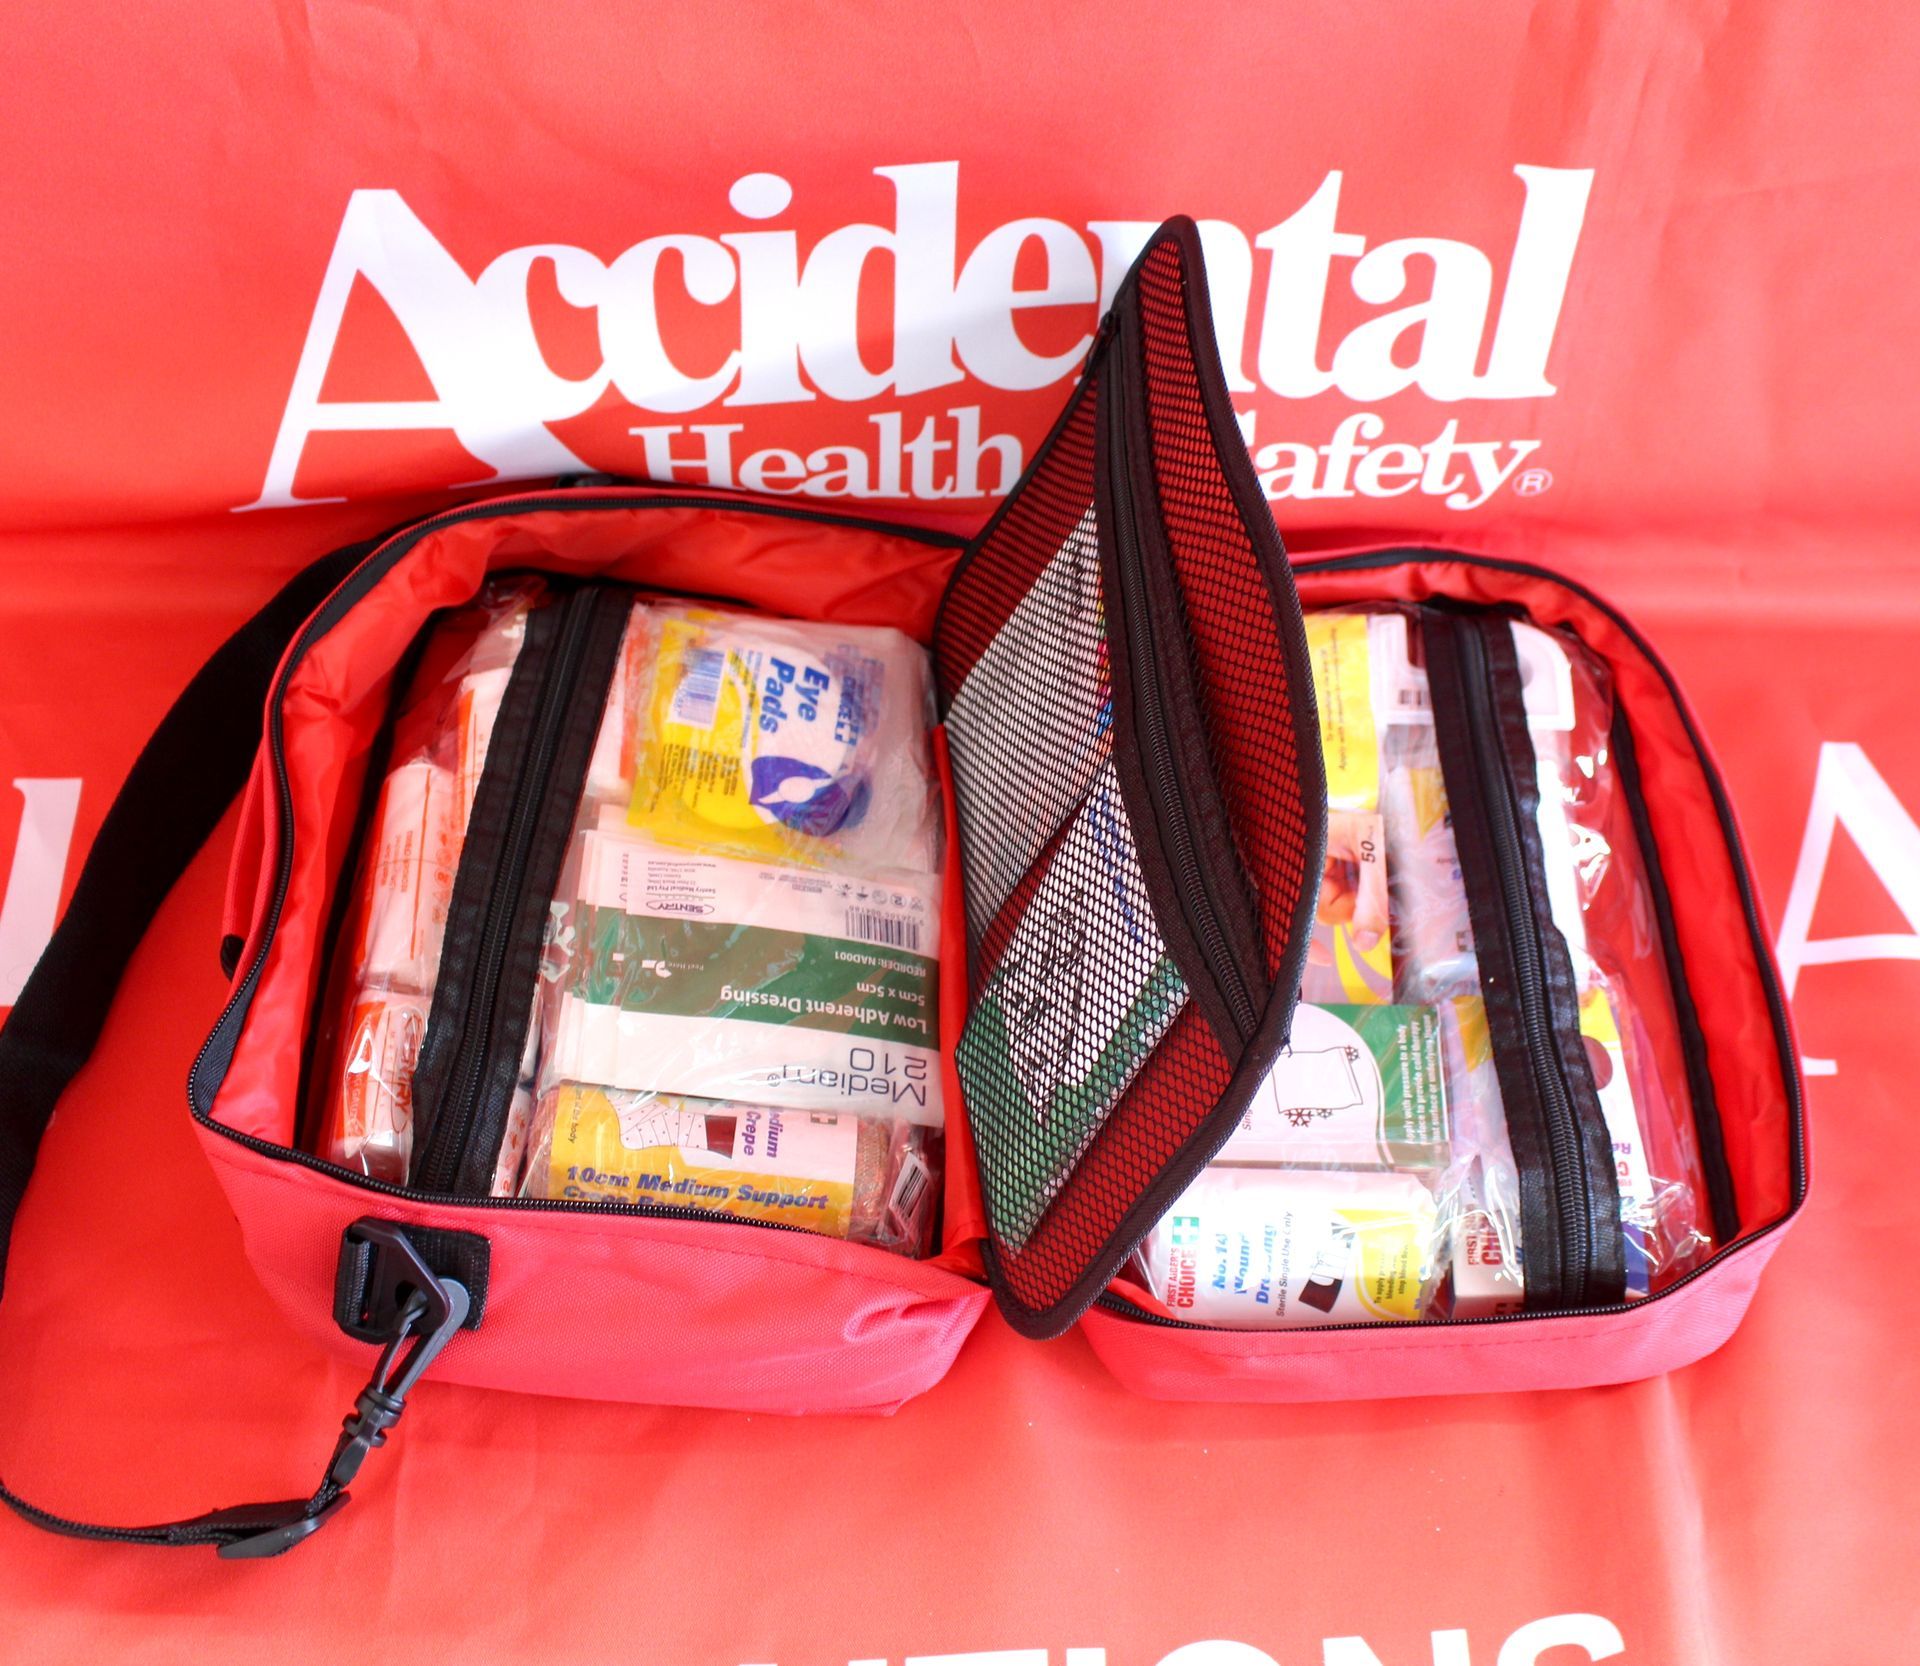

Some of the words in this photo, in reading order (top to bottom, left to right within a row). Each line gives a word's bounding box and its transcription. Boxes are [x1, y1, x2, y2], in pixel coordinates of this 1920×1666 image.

[629, 406, 1024, 500] Health
[759, 657, 797, 734] Pads
[794, 666, 830, 722] Eye
[1360, 840, 1377, 864] 50
[657, 902, 704, 915] SENTRY
[834, 950, 876, 967] NAD001
[878, 957, 927, 978] REORDER:
[720, 985, 803, 1013] Dressing
[856, 982, 886, 998] 5cm
[898, 990, 926, 1006] 5cm
[806, 998, 891, 1026] Adherent
[893, 1012, 928, 1034] Low
[849, 1047, 928, 1081] 210
[568, 1122, 580, 1145] body
[742, 1110, 763, 1157] Crepe
[567, 1165, 630, 1188] 10cm
[636, 1173, 731, 1200] Medium
[736, 1183, 830, 1210] Support
[1281, 1238, 1292, 1257] Use
[1176, 1248, 1197, 1309] CHOICE
[1278, 1258, 1292, 1288] Single
[1385, 1271, 1397, 1300] bleeding
[1166, 1284, 1178, 1308] FIRST
[1376, 1277, 1386, 1296] apply
[1398, 1280, 1407, 1295] stop
[1275, 1289, 1288, 1317] Sterile
